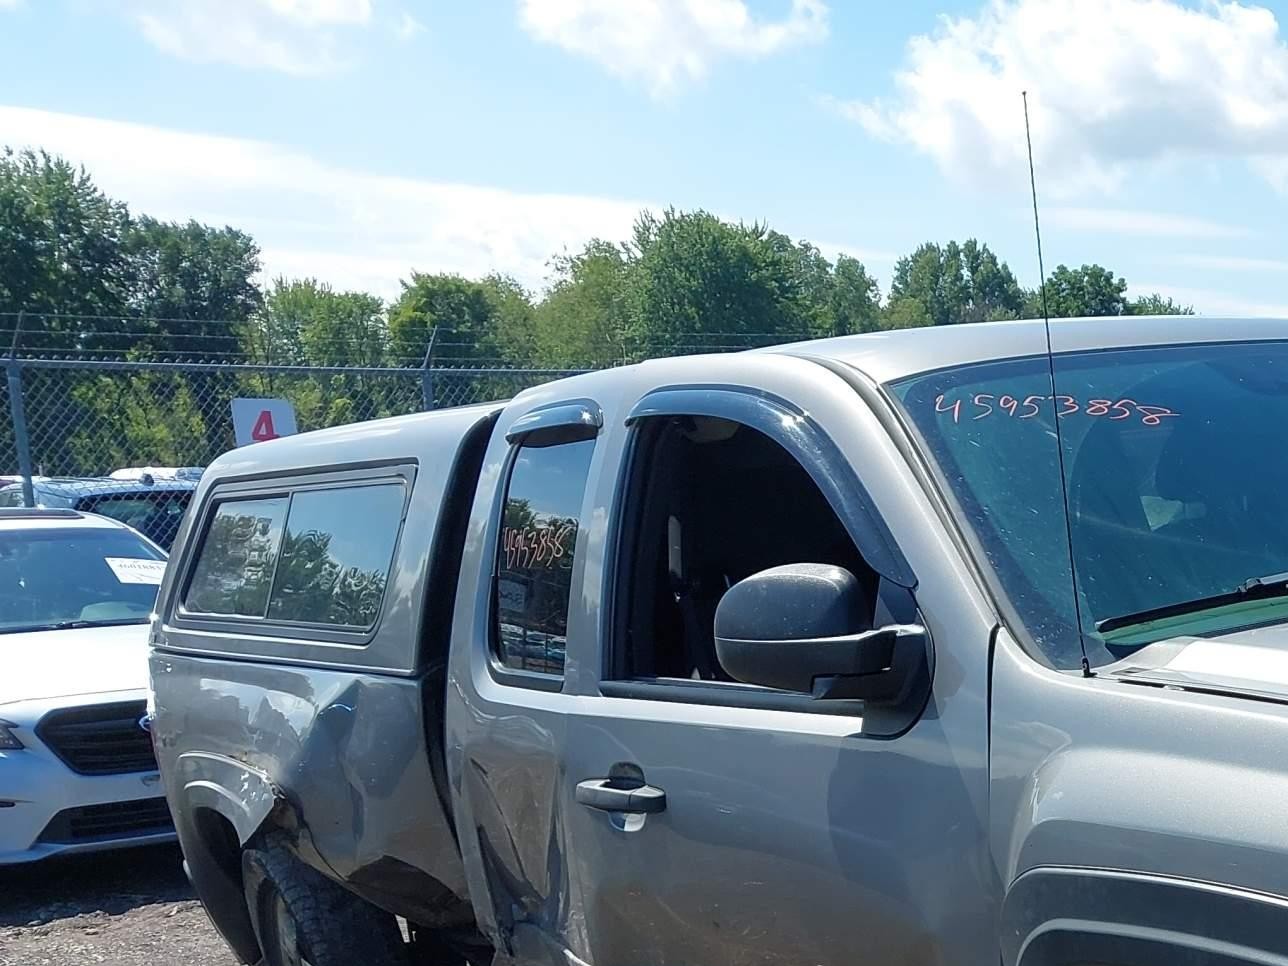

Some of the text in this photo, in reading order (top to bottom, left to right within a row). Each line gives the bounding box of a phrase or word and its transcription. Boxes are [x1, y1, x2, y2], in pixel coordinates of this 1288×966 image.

[251, 409, 281, 442] 4
[934, 393, 1182, 426] 45953858
[502, 524, 572, 570] 45953858
